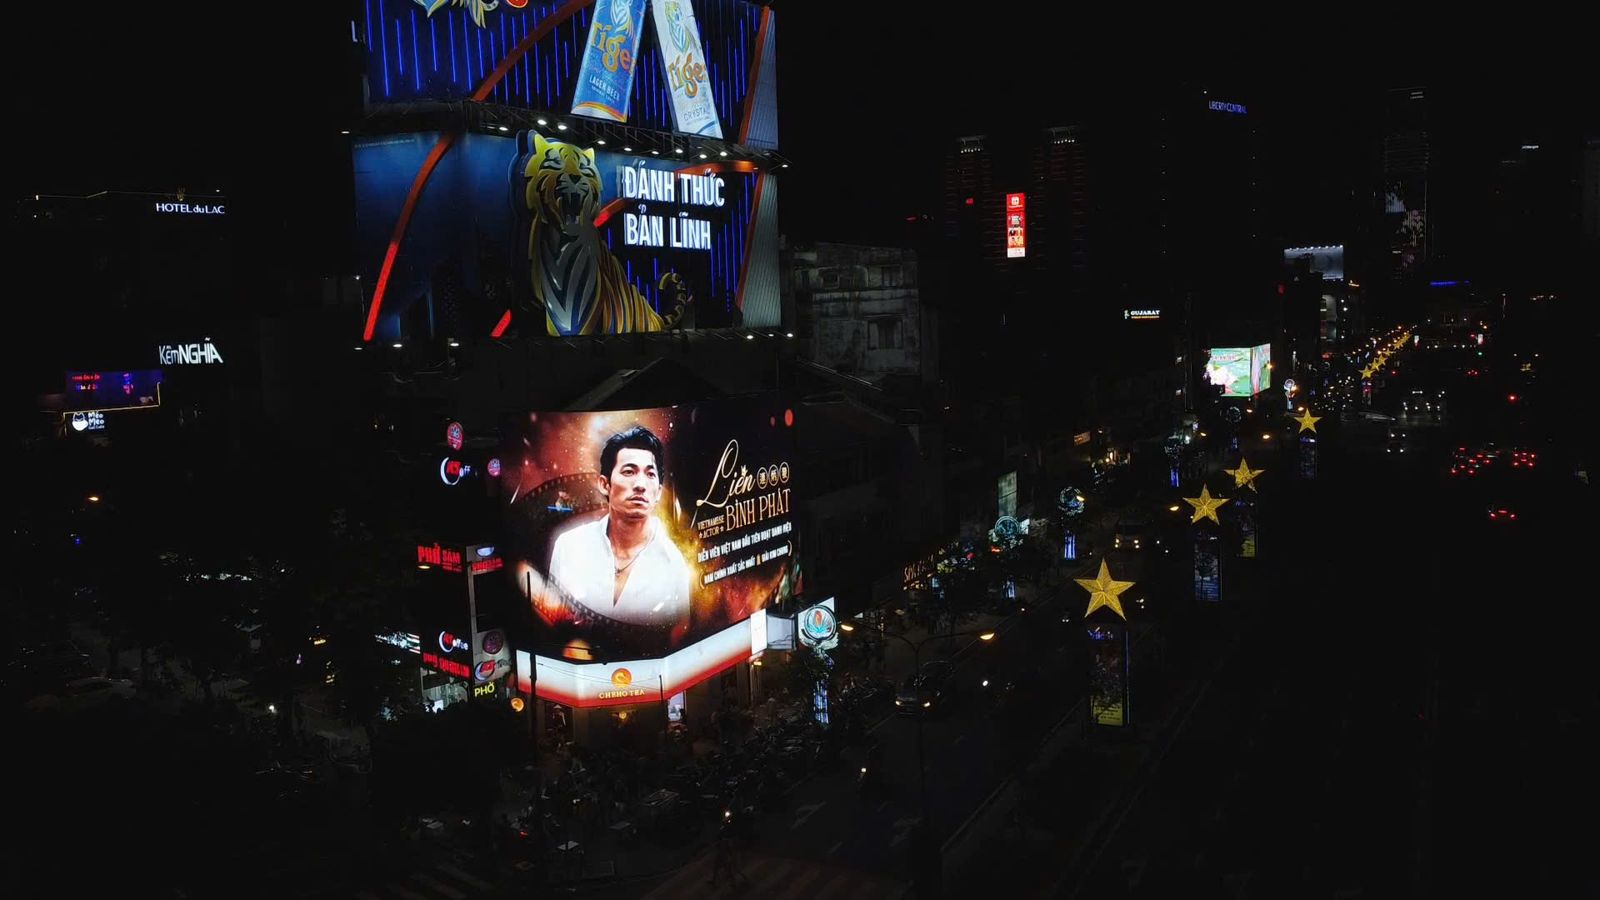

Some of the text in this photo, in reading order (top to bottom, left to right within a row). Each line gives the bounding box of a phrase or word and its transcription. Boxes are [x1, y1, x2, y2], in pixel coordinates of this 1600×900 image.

[617, 160, 725, 207] ĐÁNH THỨC
[155, 202, 192, 213] HOTEL
[624, 204, 711, 250] BẢN LĨNH
